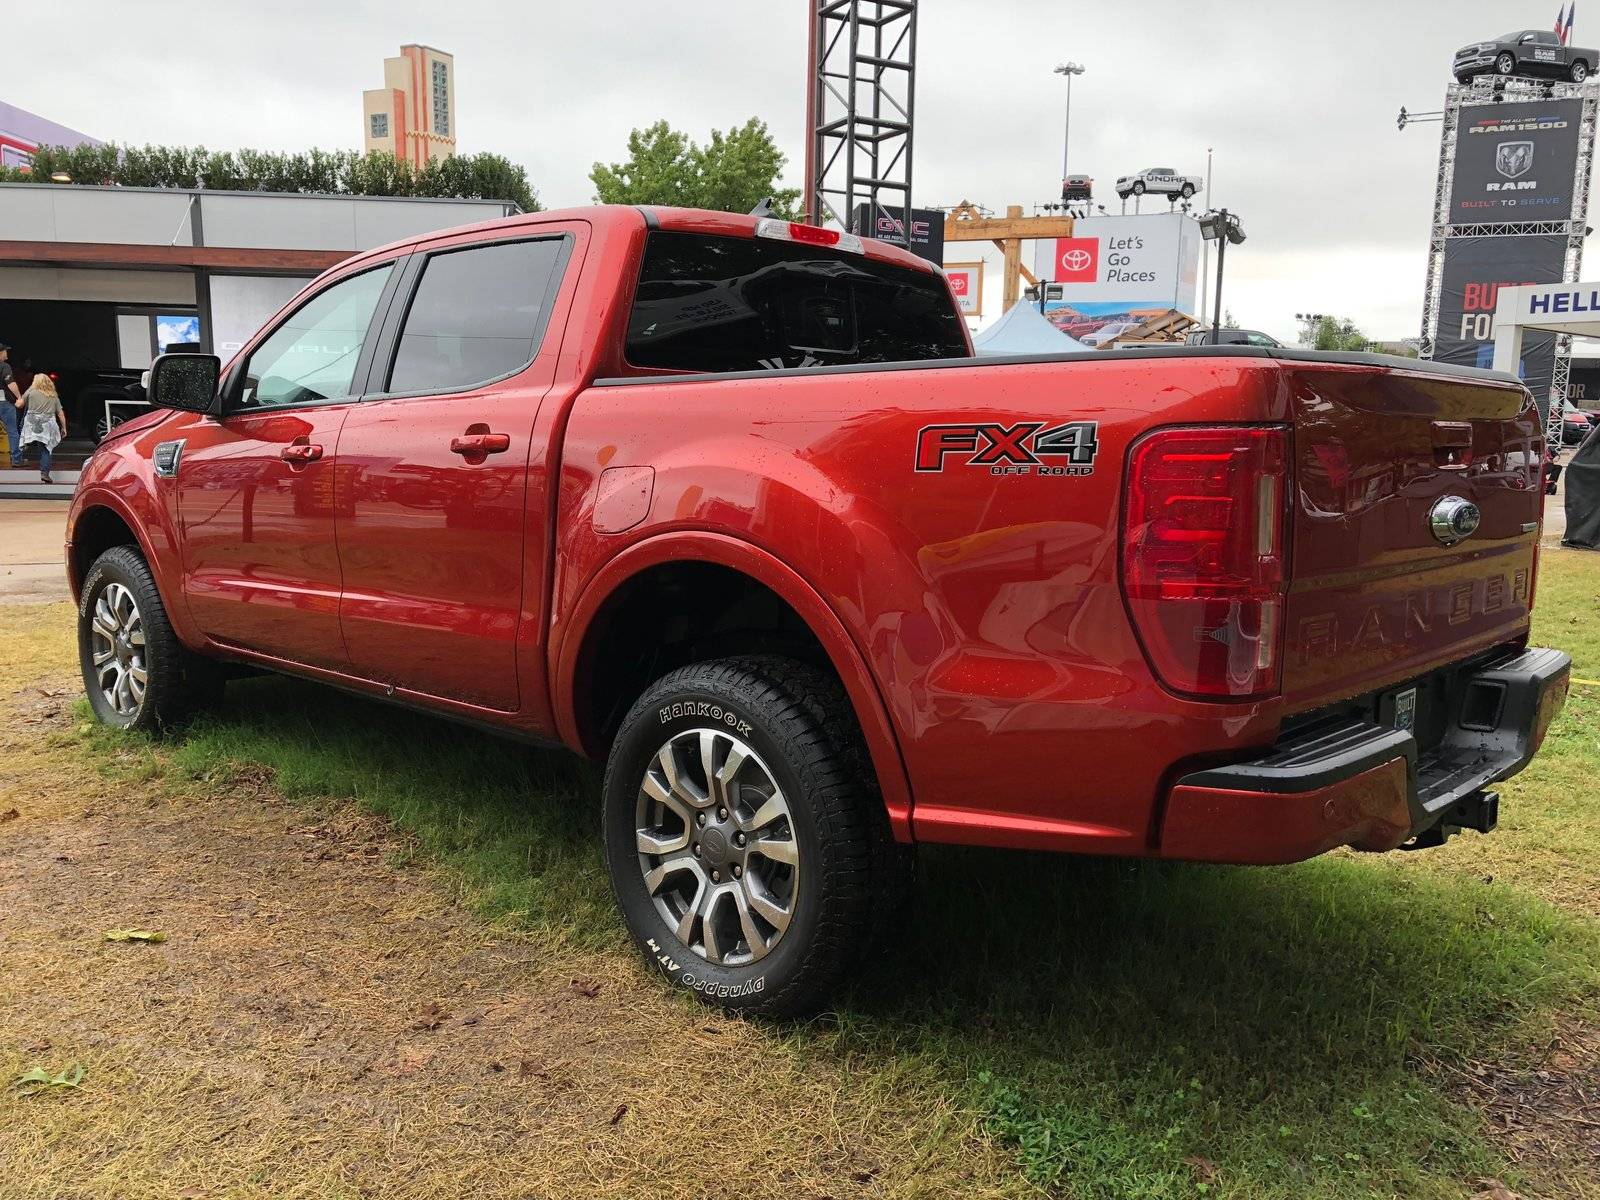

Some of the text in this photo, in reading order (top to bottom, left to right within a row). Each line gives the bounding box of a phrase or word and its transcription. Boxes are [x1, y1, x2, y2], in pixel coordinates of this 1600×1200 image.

[1469, 121, 1568, 133] RAM 1500
[1486, 181, 1537, 191] RAM
[1461, 200, 1497, 208] BUILT
[1520, 197, 1560, 206] SERVE
[1108, 236, 1144, 250] Let's
[1108, 253, 1130, 266] Go
[1107, 268, 1156, 282] Places
[914, 421, 1099, 472] FX4
[991, 466, 1095, 477] OFF ROAD
[1299, 567, 1530, 664] RANGER
